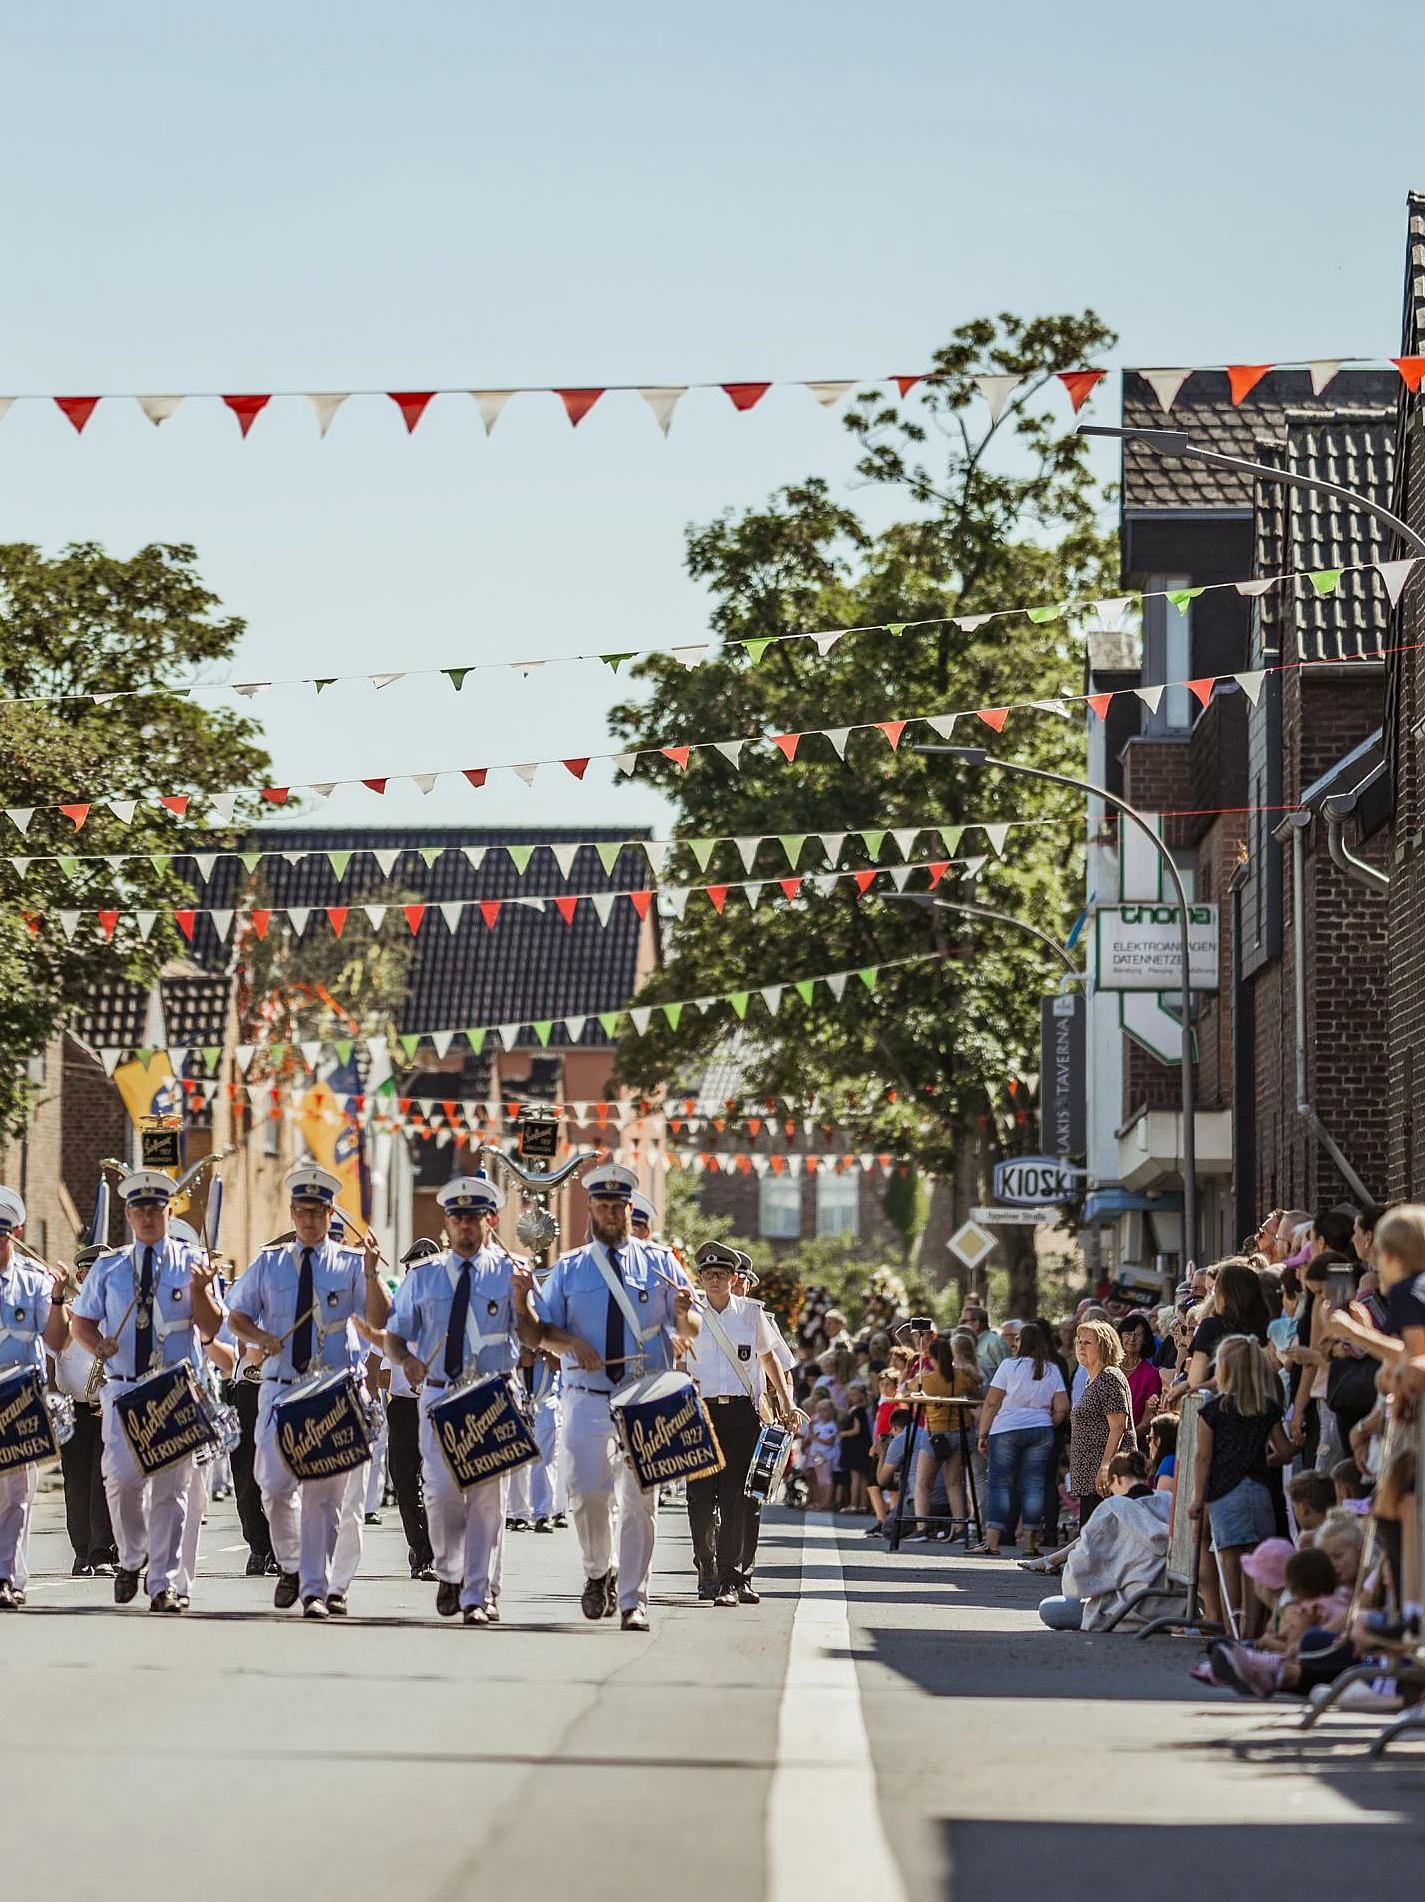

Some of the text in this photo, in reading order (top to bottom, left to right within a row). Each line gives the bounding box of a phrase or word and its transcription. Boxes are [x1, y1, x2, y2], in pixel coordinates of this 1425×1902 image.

[1120, 906, 1211, 925] thoma
[1113, 942, 1216, 952] ELEKTROANAGEN
[1056, 1018, 1071, 1154] LAKIS TAVERNA
[1001, 1168, 1069, 1198] KIOSK
[16, 1414, 39, 1436] 1927
[174, 1402, 196, 1426] 1927
[332, 1426, 354, 1448] 1927
[493, 1420, 517, 1443] 1927
[679, 1424, 703, 1447] 1927
[296, 1444, 366, 1476] UERDINGEN
[457, 1438, 532, 1480] UERDINGEN
[641, 1444, 715, 1481] UERDINGEN
